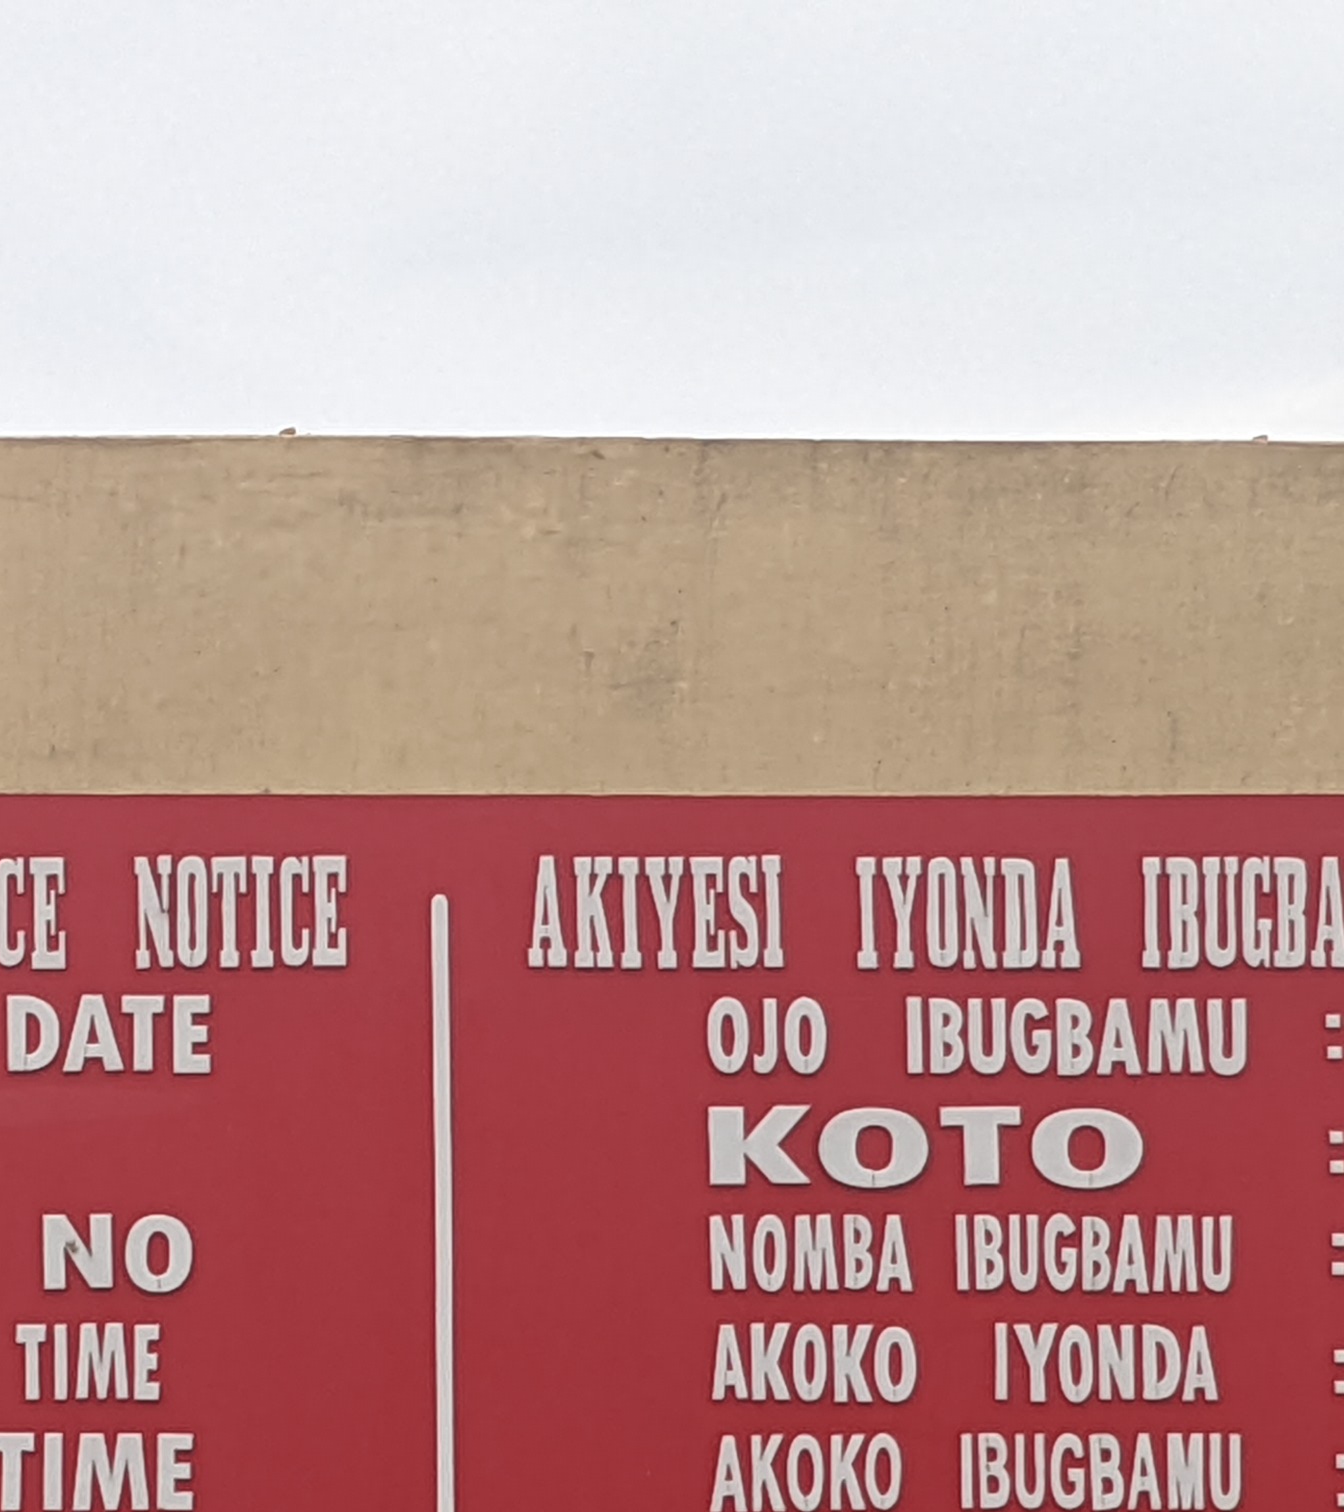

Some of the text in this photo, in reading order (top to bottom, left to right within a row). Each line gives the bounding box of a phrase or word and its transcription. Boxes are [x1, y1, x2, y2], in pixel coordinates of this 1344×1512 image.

[134, 854, 348, 970] NOTICE
[527, 854, 785, 970] AKIYESI
[855, 856, 1082, 970] IYONDA
[6, 994, 212, 1074] DATE
[707, 996, 828, 1075] OJO
[906, 996, 1248, 1077] IBUGBAMU
[707, 1104, 1145, 1190] KOTO
[42, 1213, 194, 1293] NO
[709, 1213, 914, 1293] NOMBA
[955, 1213, 1233, 1294] IBUGBAMU
[15, 1322, 161, 1401] TIME
[712, 1322, 918, 1403] AKOKO
[995, 1322, 1219, 1404] IYONDA
[960, 1432, 1242, 1512] IBUGBAMU
